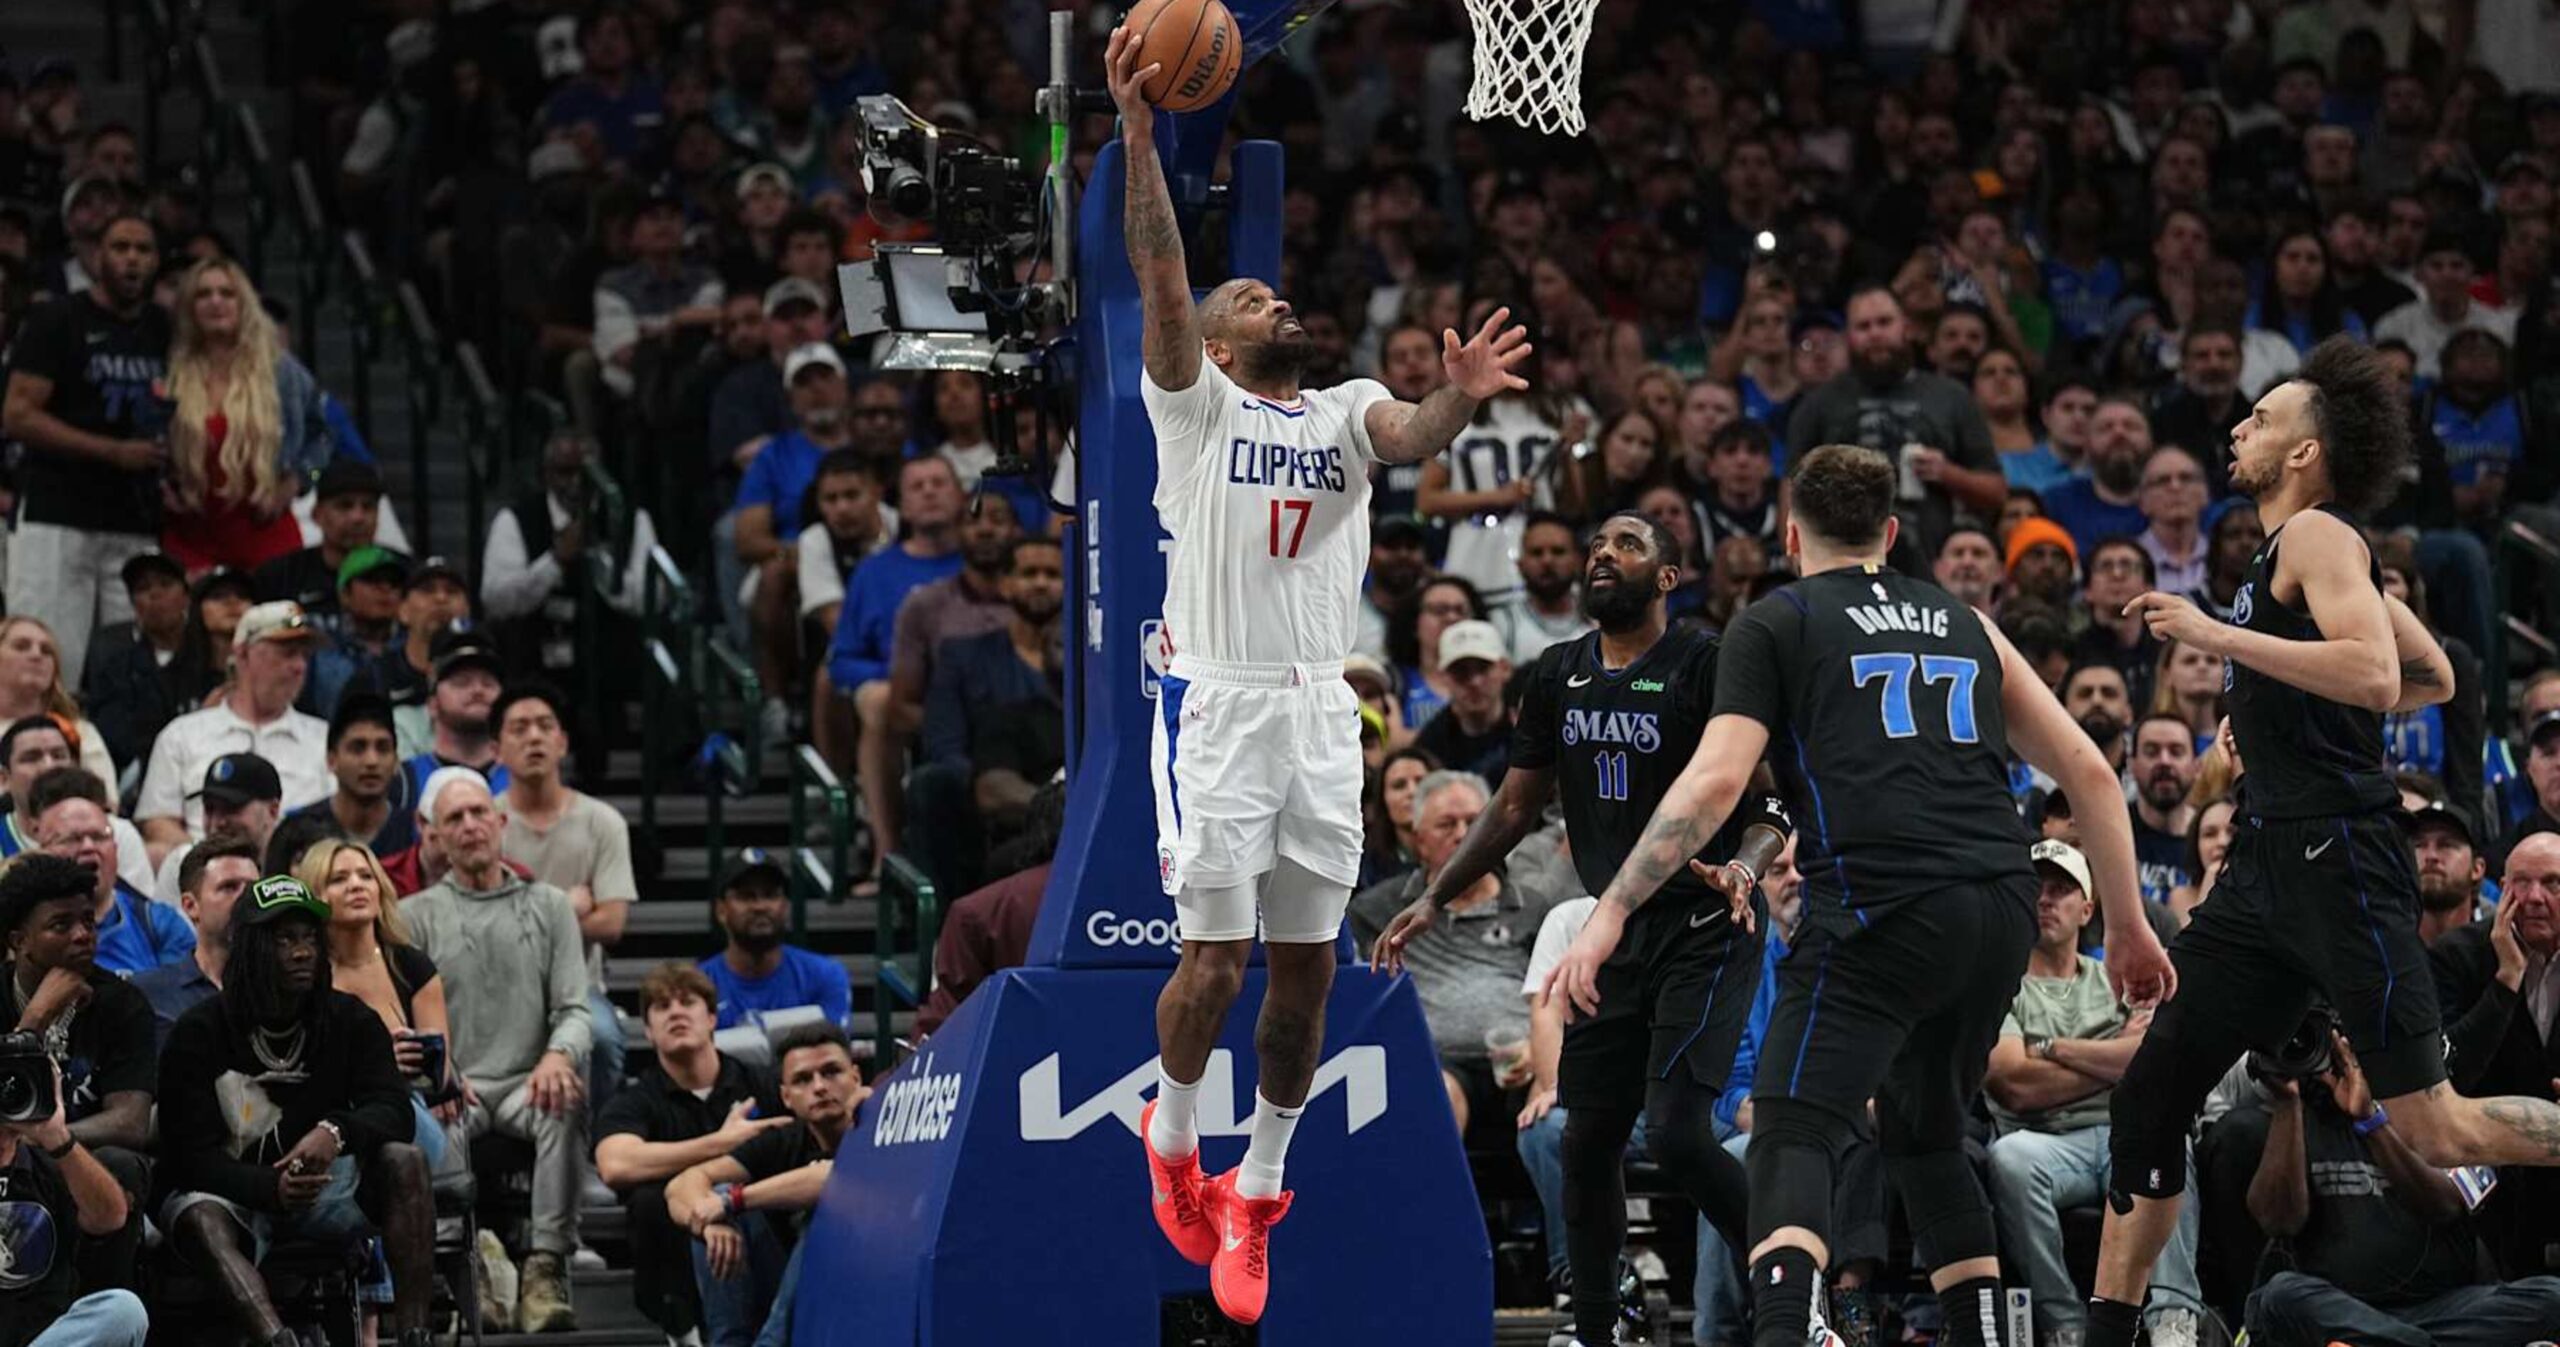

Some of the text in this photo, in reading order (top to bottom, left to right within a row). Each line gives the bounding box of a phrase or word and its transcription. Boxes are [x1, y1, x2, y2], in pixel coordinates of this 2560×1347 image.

[1177, 25, 1226, 98] Wilson
[1228, 437, 1346, 494] CLIPPERS
[1268, 498, 1313, 559] 17
[1845, 601, 1949, 638] DONČIĆ
[1631, 678, 1664, 692] chime
[1850, 652, 1980, 744] 77
[1562, 708, 1661, 753] MAVS
[1594, 750, 1628, 801] 11
[1086, 910, 1183, 954] Goog
[874, 1051, 961, 1147] coinbase
